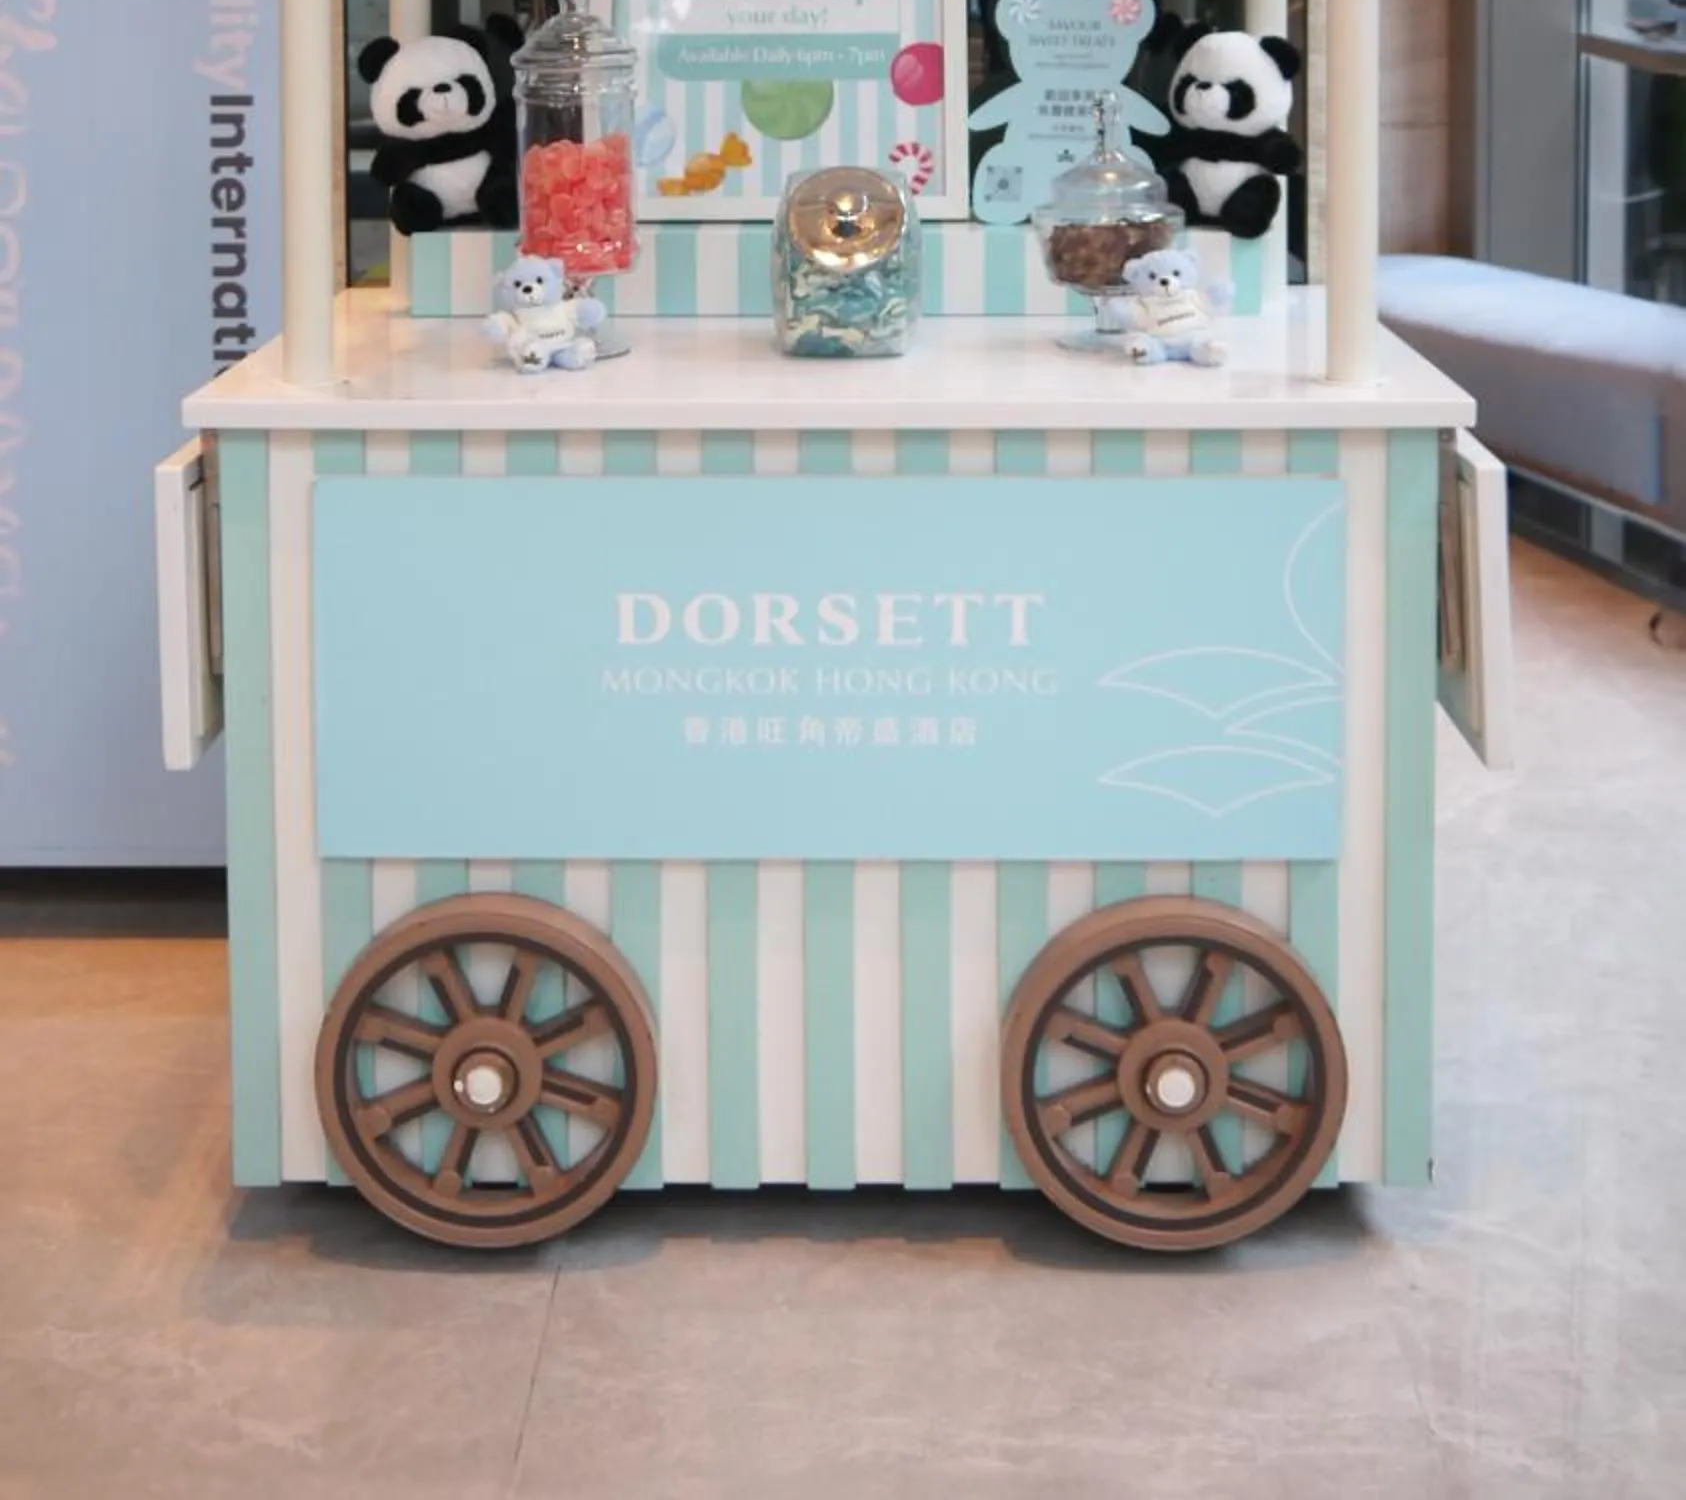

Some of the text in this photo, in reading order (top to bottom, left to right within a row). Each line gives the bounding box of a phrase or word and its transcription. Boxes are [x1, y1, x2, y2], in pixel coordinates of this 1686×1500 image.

[726, 7, 828, 25] your day!
[678, 47, 746, 64] Available
[753, 47, 791, 64] Daily
[797, 47, 834, 67] 6pm
[848, 47, 886, 67] 7pm
[615, 593, 1047, 647] DORSETT
[600, 667, 1058, 695] MONGKOK HONG KONG
[683, 715, 978, 747] 香港旺角帝盛酒店
